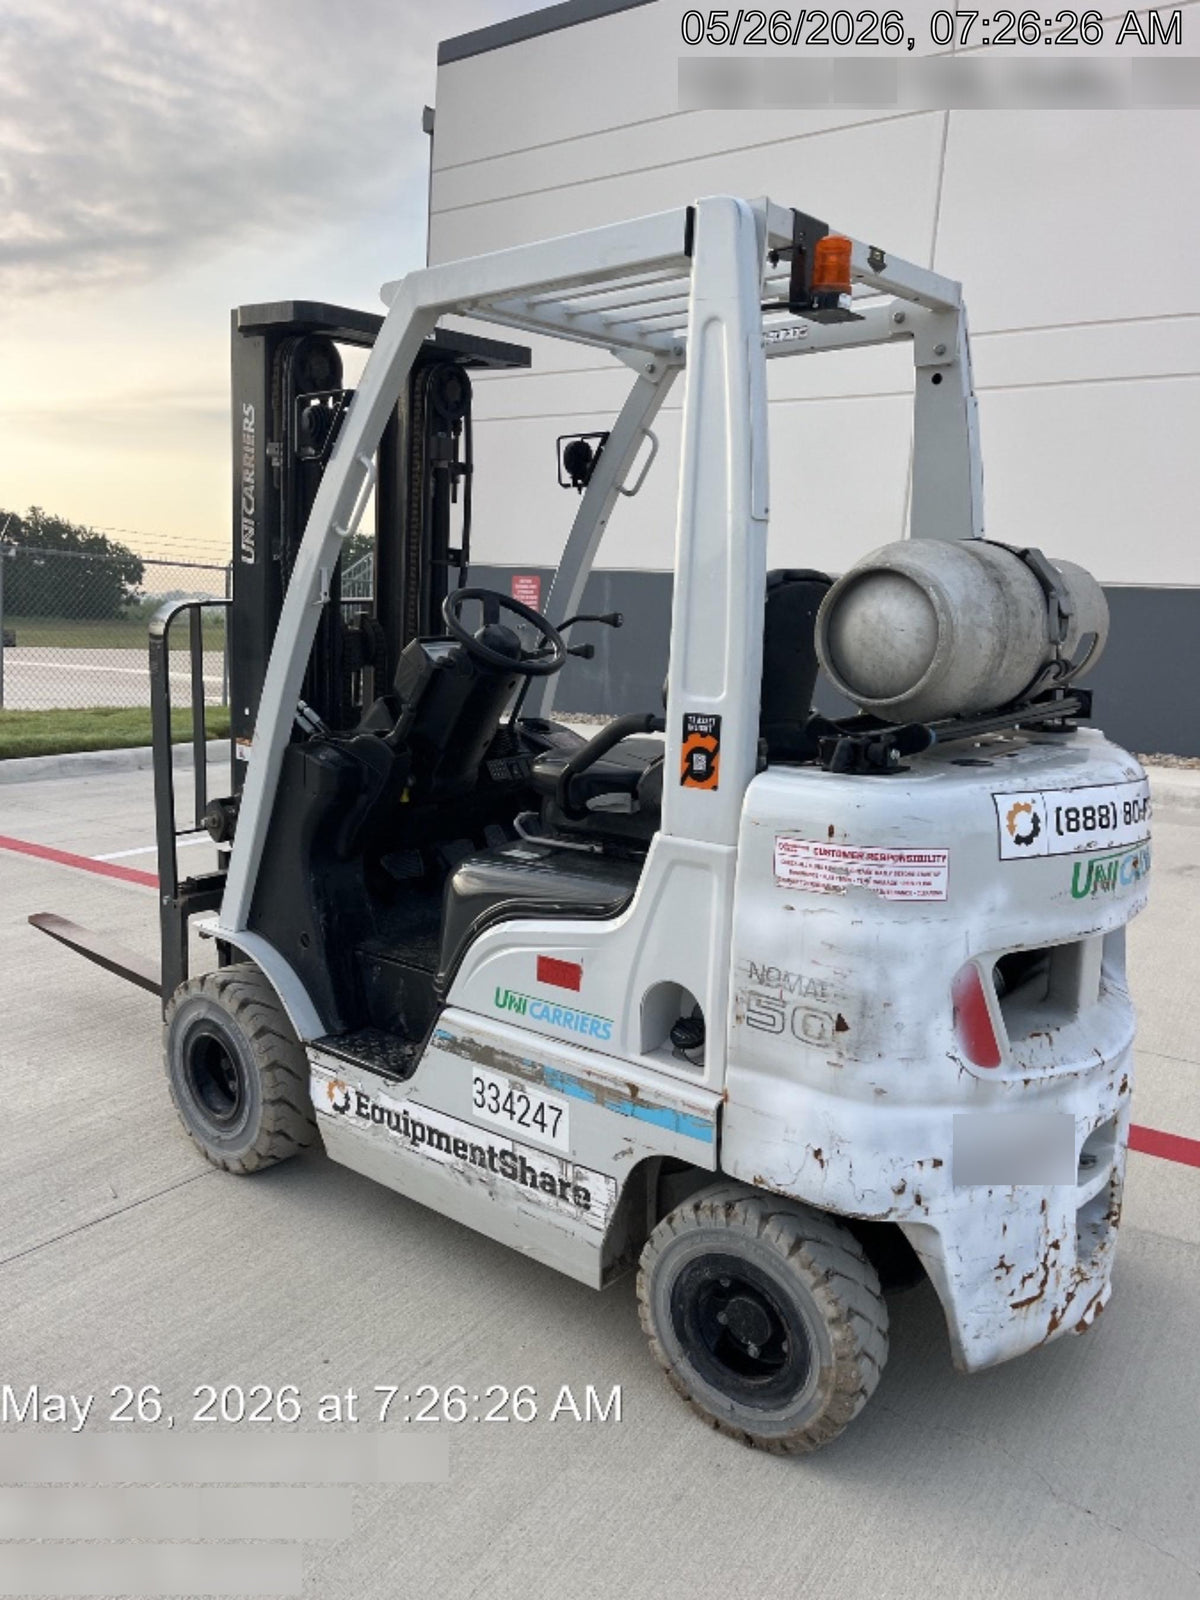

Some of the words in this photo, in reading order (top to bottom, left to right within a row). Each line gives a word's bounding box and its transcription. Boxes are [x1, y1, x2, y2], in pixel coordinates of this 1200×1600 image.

[1055, 802, 1117, 836] (888)
[813, 847, 864, 861] CUSTOMER
[865, 853, 947, 863] RESPONSIBILITY
[745, 990, 837, 1048] 50
[473, 1077, 564, 1139] 334247
[355, 1090, 593, 1212] EquipmentShare
